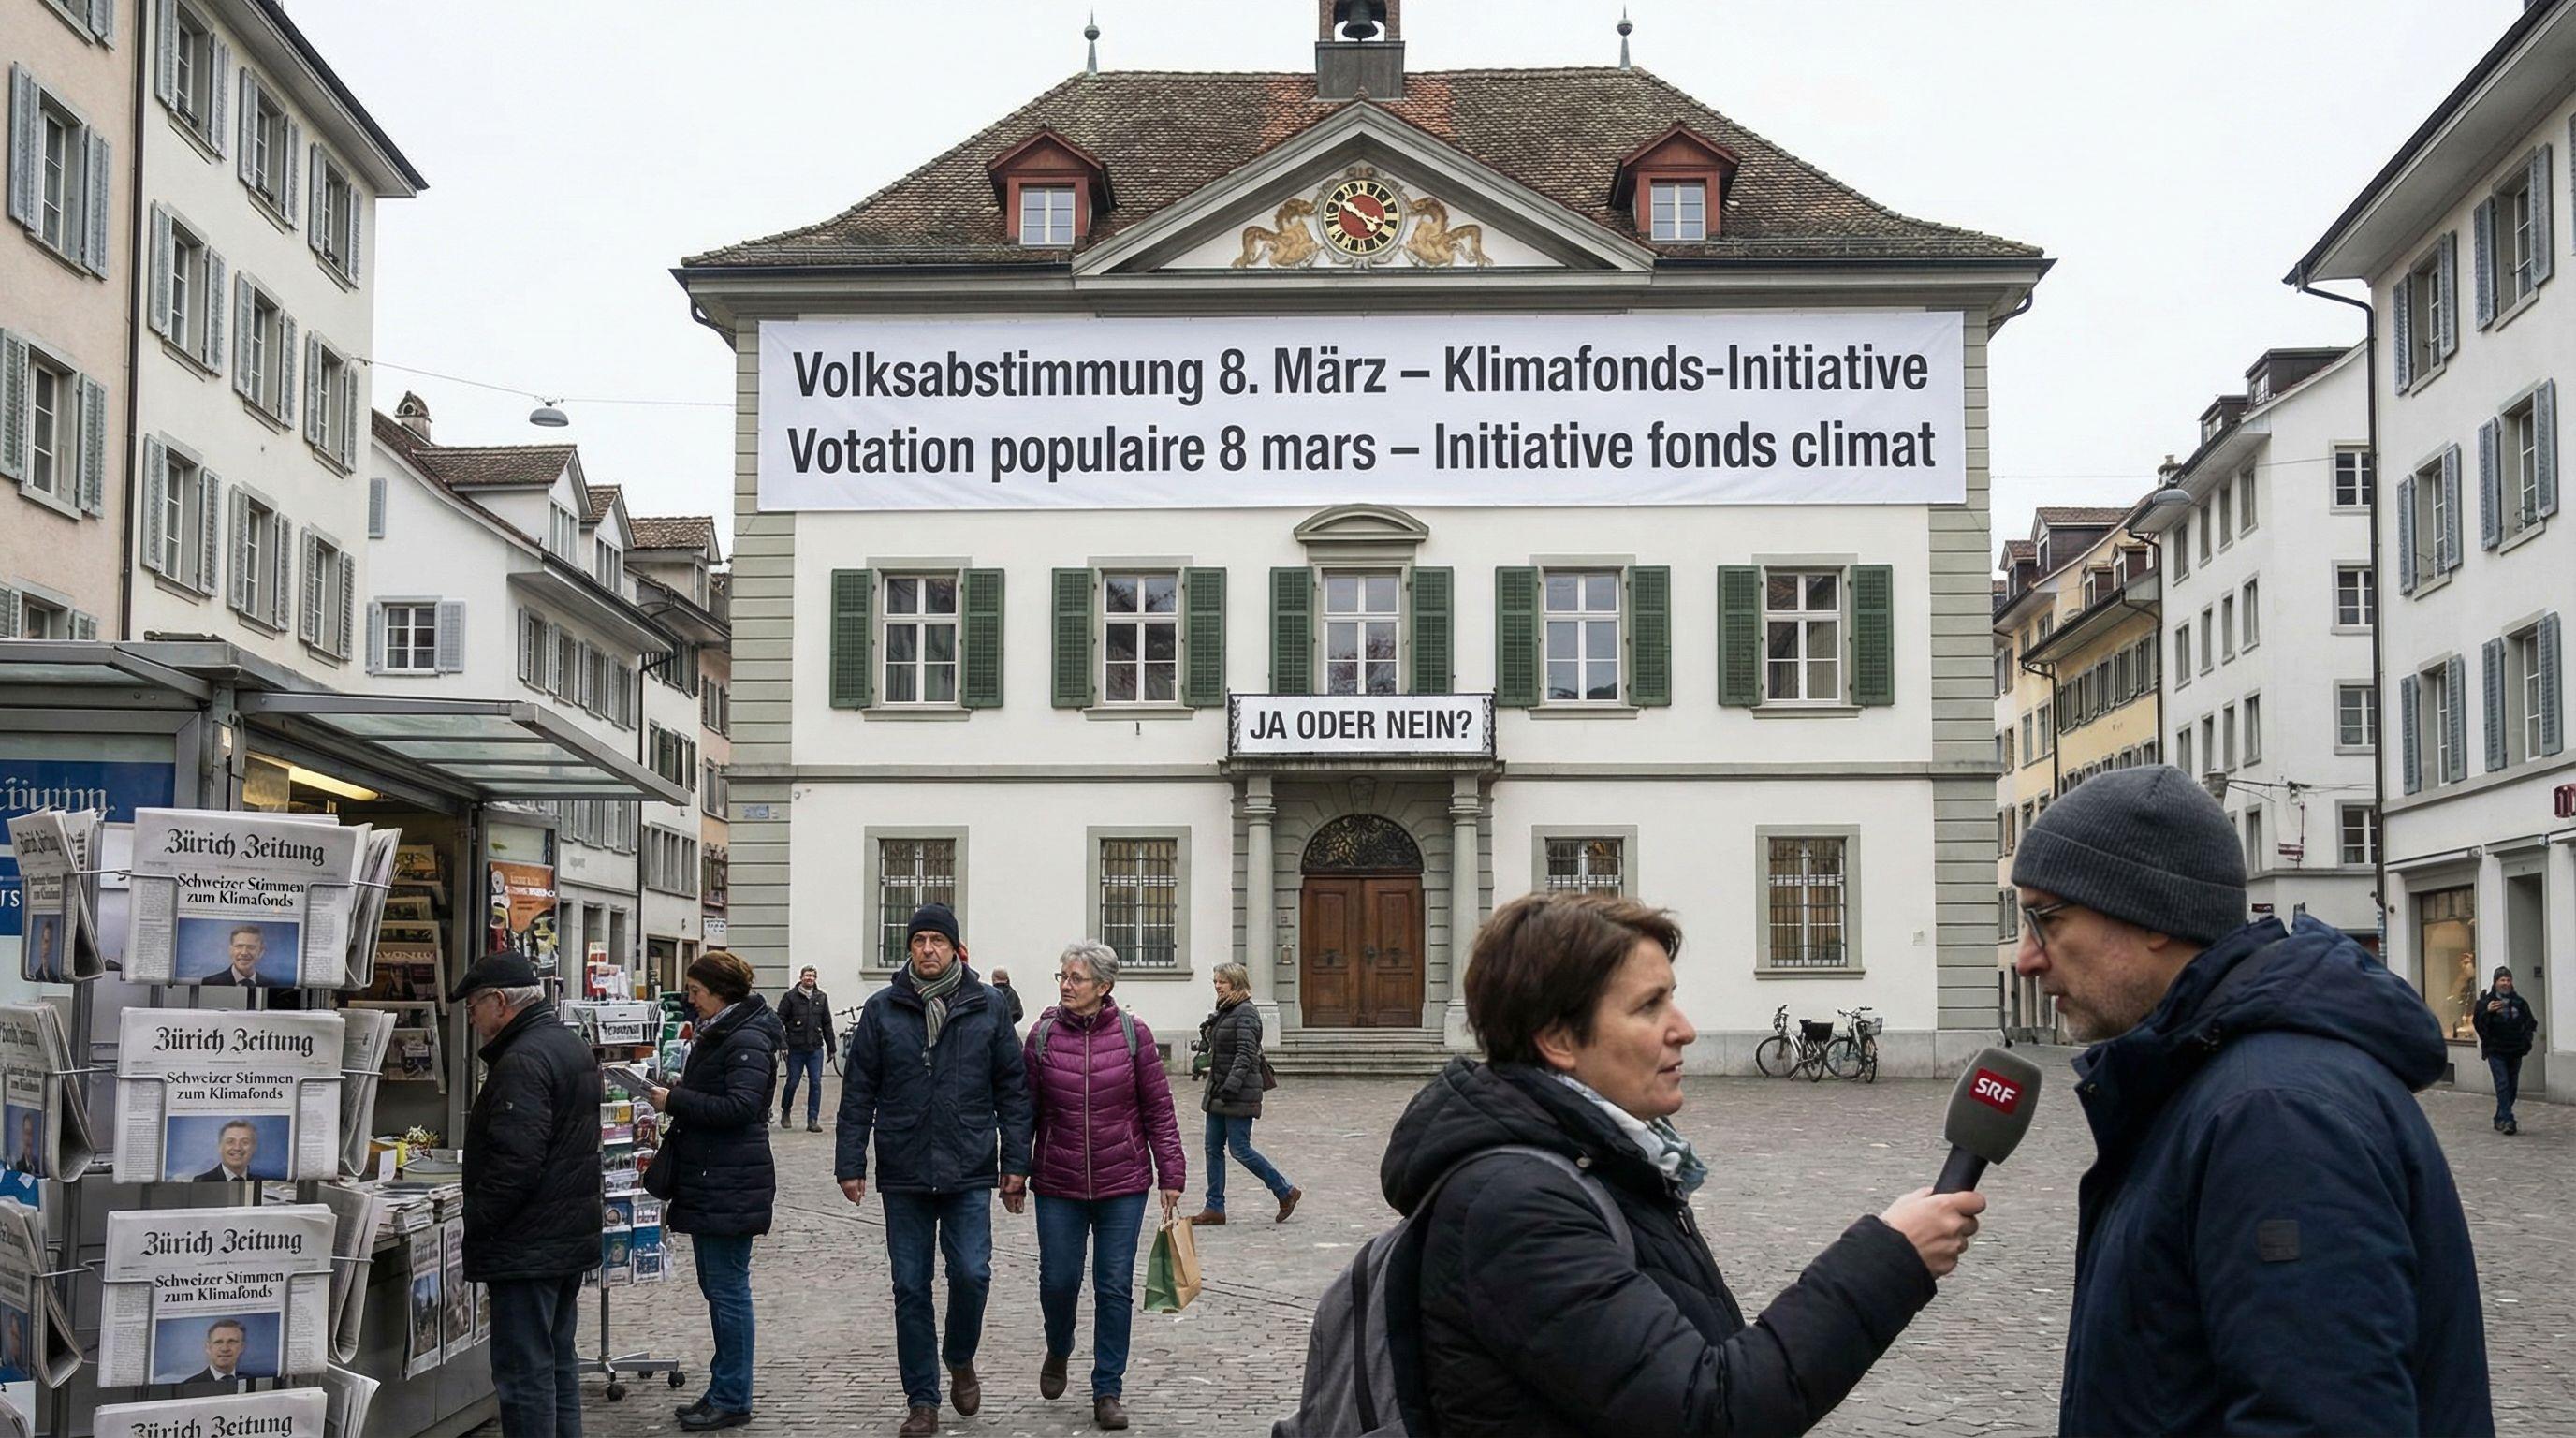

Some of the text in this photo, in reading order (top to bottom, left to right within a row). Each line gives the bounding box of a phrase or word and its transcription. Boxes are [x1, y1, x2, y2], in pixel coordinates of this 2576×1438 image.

[793, 350, 1204, 405] Volksabstimmung
[1219, 348, 1259, 395] 8.
[1274, 346, 1386, 394] März
[1444, 343, 1928, 392] Klimafonds-Initiative
[787, 426, 974, 474] Votation
[991, 425, 1205, 482] populaire
[1220, 425, 1247, 472] 8
[1262, 433, 1376, 471] mars
[1434, 421, 1632, 470] Initiative
[1647, 420, 1776, 469] fonds
[1792, 420, 1936, 468] climat
[1250, 710, 1473, 740] JA ODER NEIN?
[164, 829, 325, 866] Zürich Zeitung
[177, 873, 304, 893] Schweizer Stimmen
[187, 890, 294, 907] zum Klimafonds
[152, 1026, 314, 1057] Zürich Zeitung
[167, 1071, 294, 1084] Schweizer Stimmen
[177, 1087, 283, 1100] zum Klimafonds
[1974, 1078, 2016, 1103] SRF
[140, 1228, 302, 1256] Zürich Zeitung
[154, 1270, 284, 1288] Schweizer Stimmen
[164, 1284, 273, 1303] zum Klimafonds
[211, 1415, 293, 1438] Zeitung
